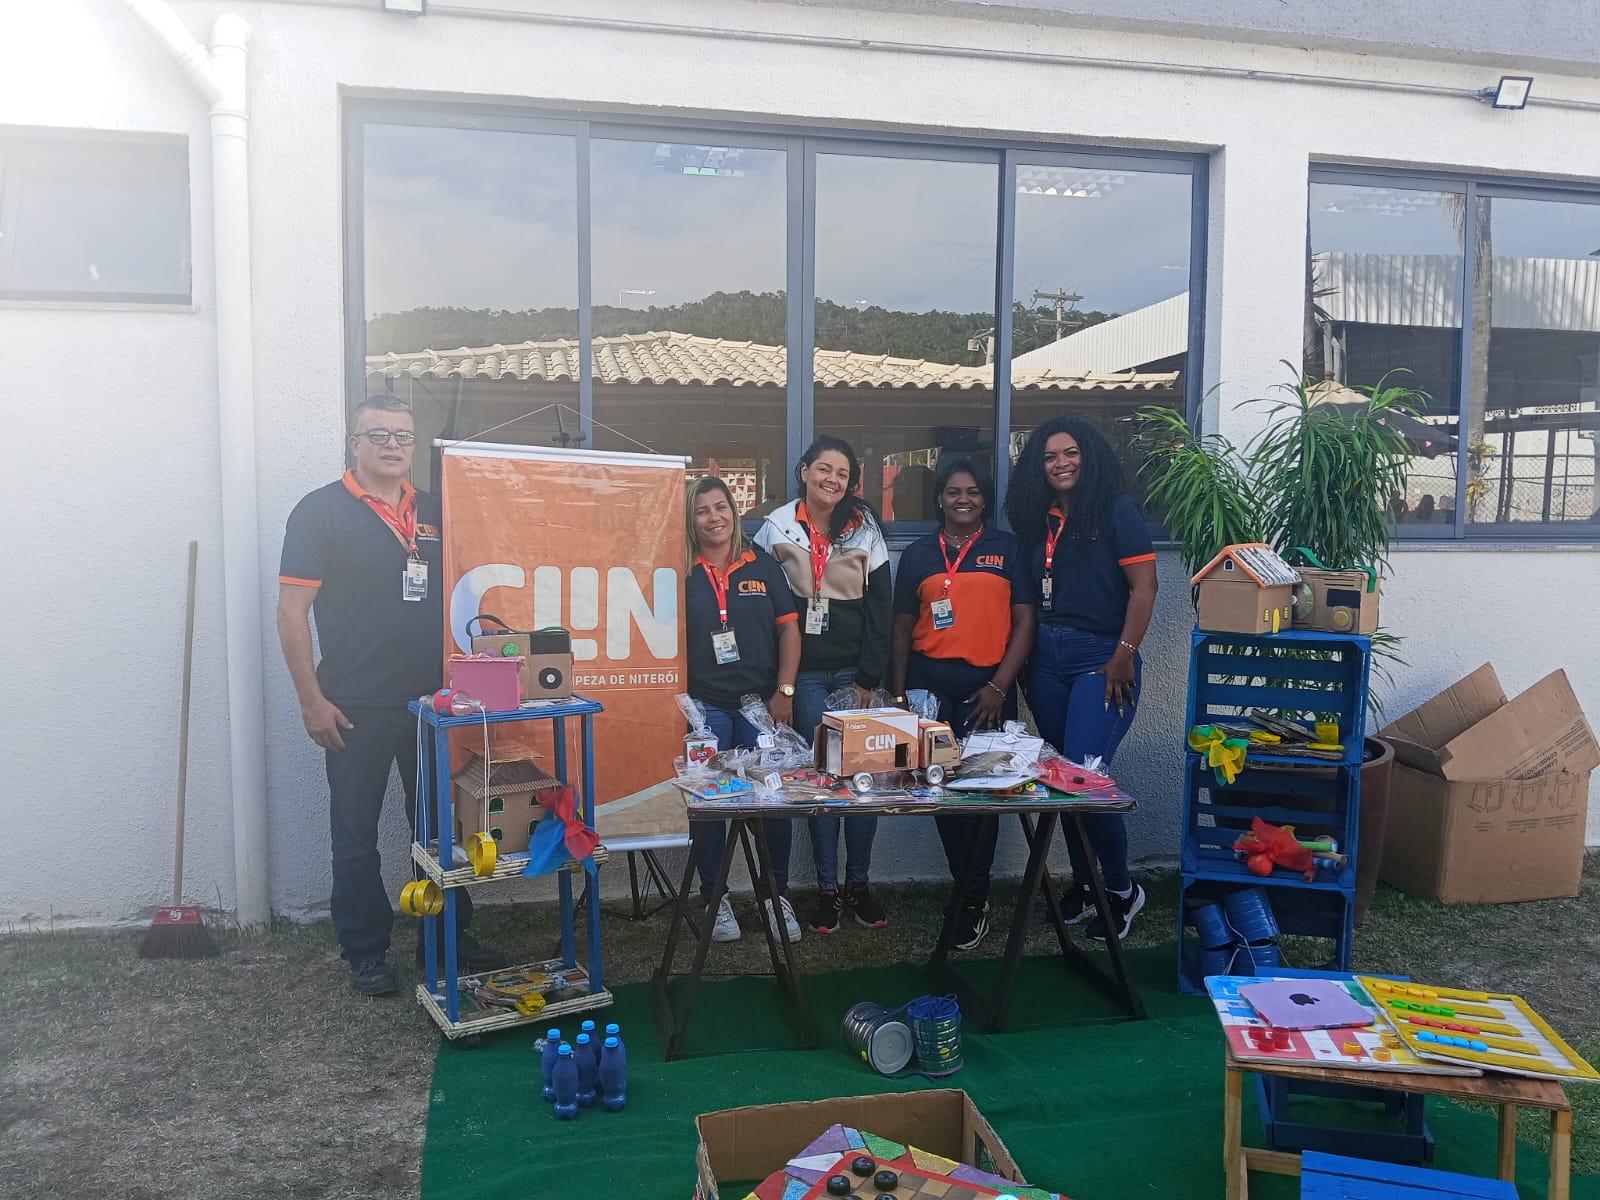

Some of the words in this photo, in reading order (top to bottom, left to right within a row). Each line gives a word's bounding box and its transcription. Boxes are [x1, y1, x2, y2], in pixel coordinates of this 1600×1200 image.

[738, 580, 767, 592] CLIN
[610, 674, 625, 684] DE
[629, 670, 679, 684] NITERÓI
[865, 734, 896, 751] CLIN
